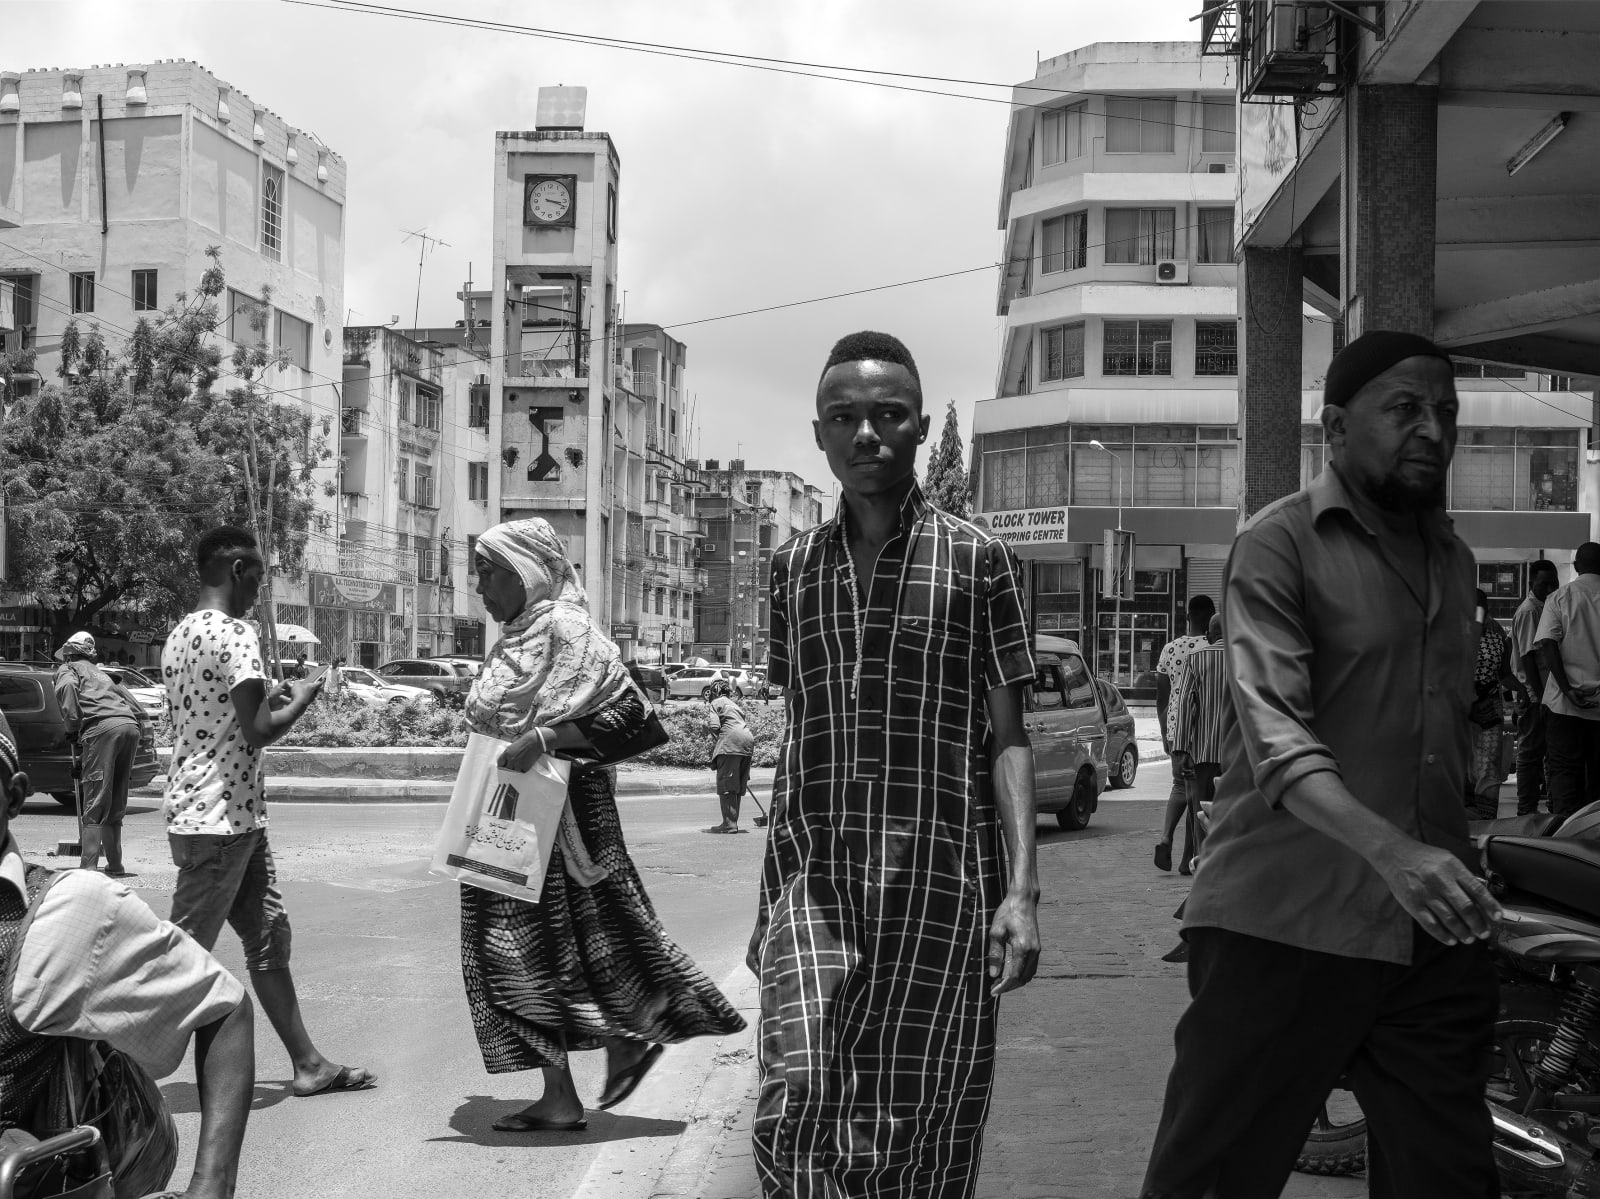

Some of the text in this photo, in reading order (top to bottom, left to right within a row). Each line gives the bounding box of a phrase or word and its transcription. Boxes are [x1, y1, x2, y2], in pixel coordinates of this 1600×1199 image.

[992, 510, 1066, 528] CLOCK TOWER
[1033, 529, 1064, 541] CENTRE
